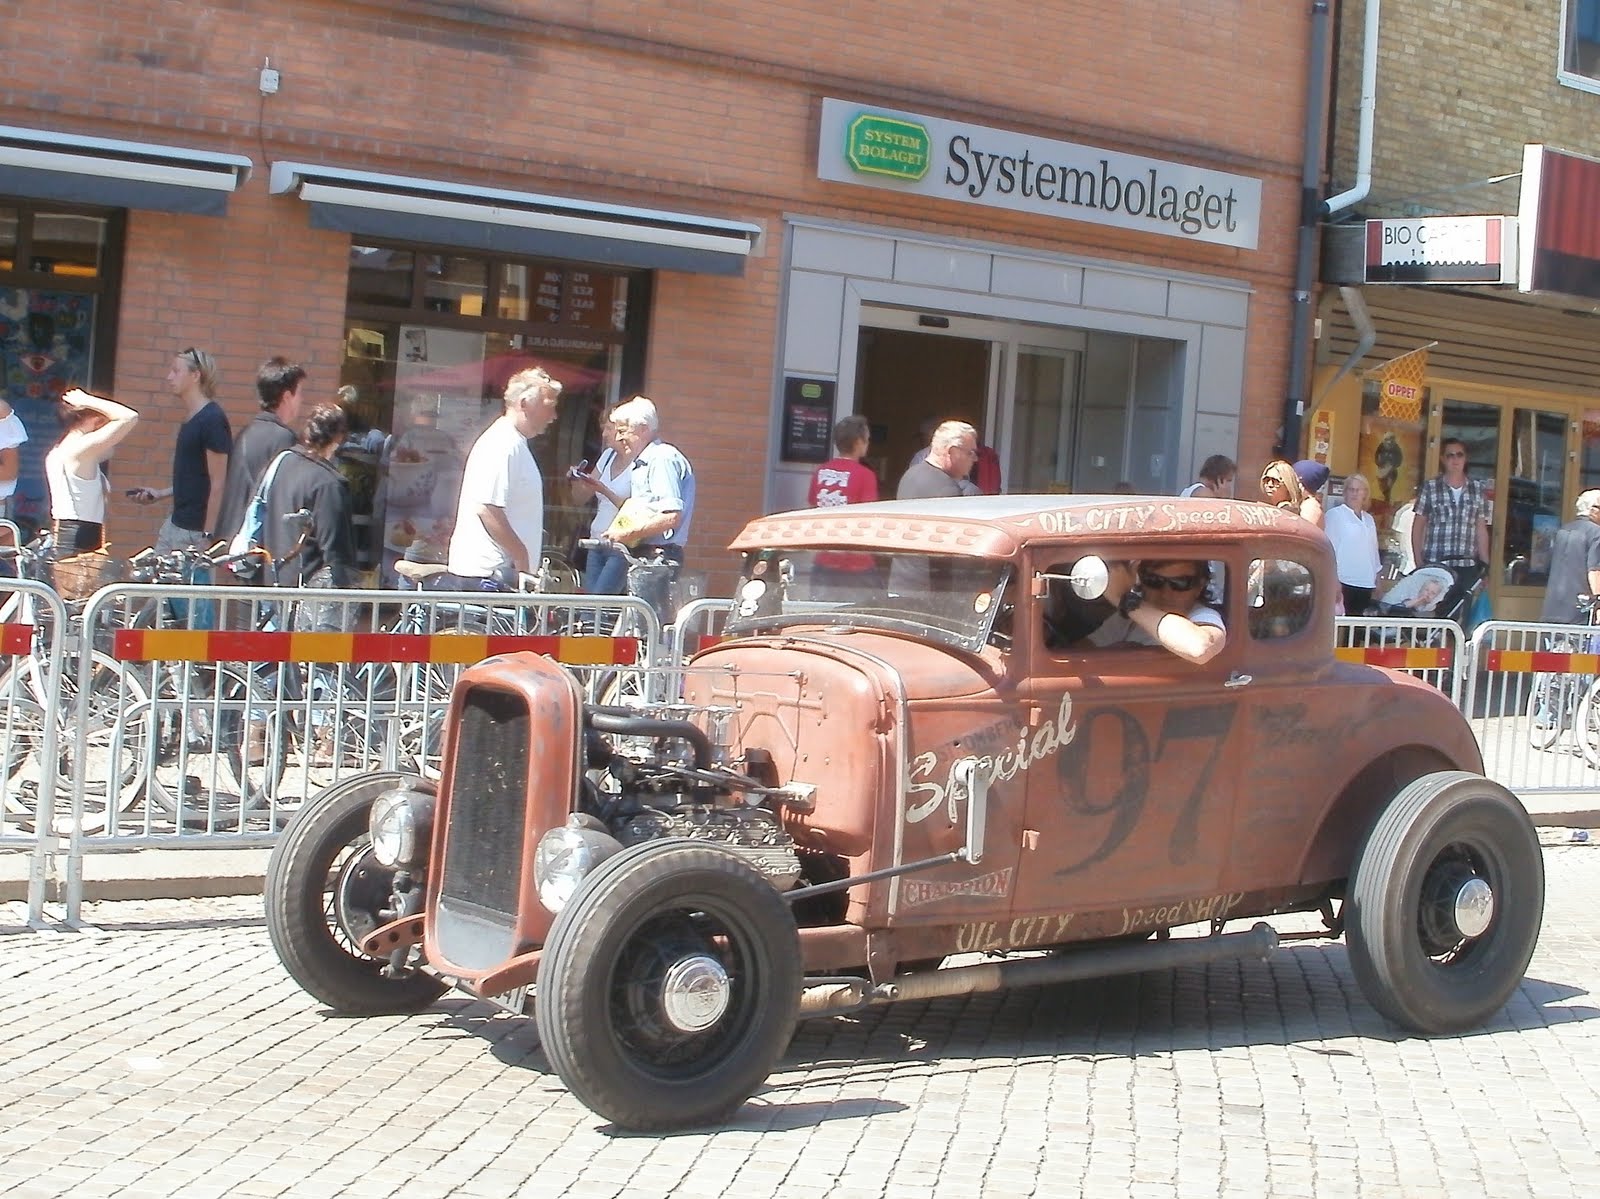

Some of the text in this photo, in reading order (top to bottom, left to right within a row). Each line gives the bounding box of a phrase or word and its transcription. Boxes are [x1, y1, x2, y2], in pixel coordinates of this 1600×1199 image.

[859, 143, 924, 166] BOLAGET
[864, 129, 921, 150] SYSTEM
[945, 134, 1238, 235] Systembolaget
[1384, 225, 1412, 246] BIO
[1038, 503, 1283, 534] OIL CITY Speed SHOP
[1054, 703, 1239, 875] 97
[956, 920, 1002, 952] OIL
[1009, 912, 1075, 947] CITY
